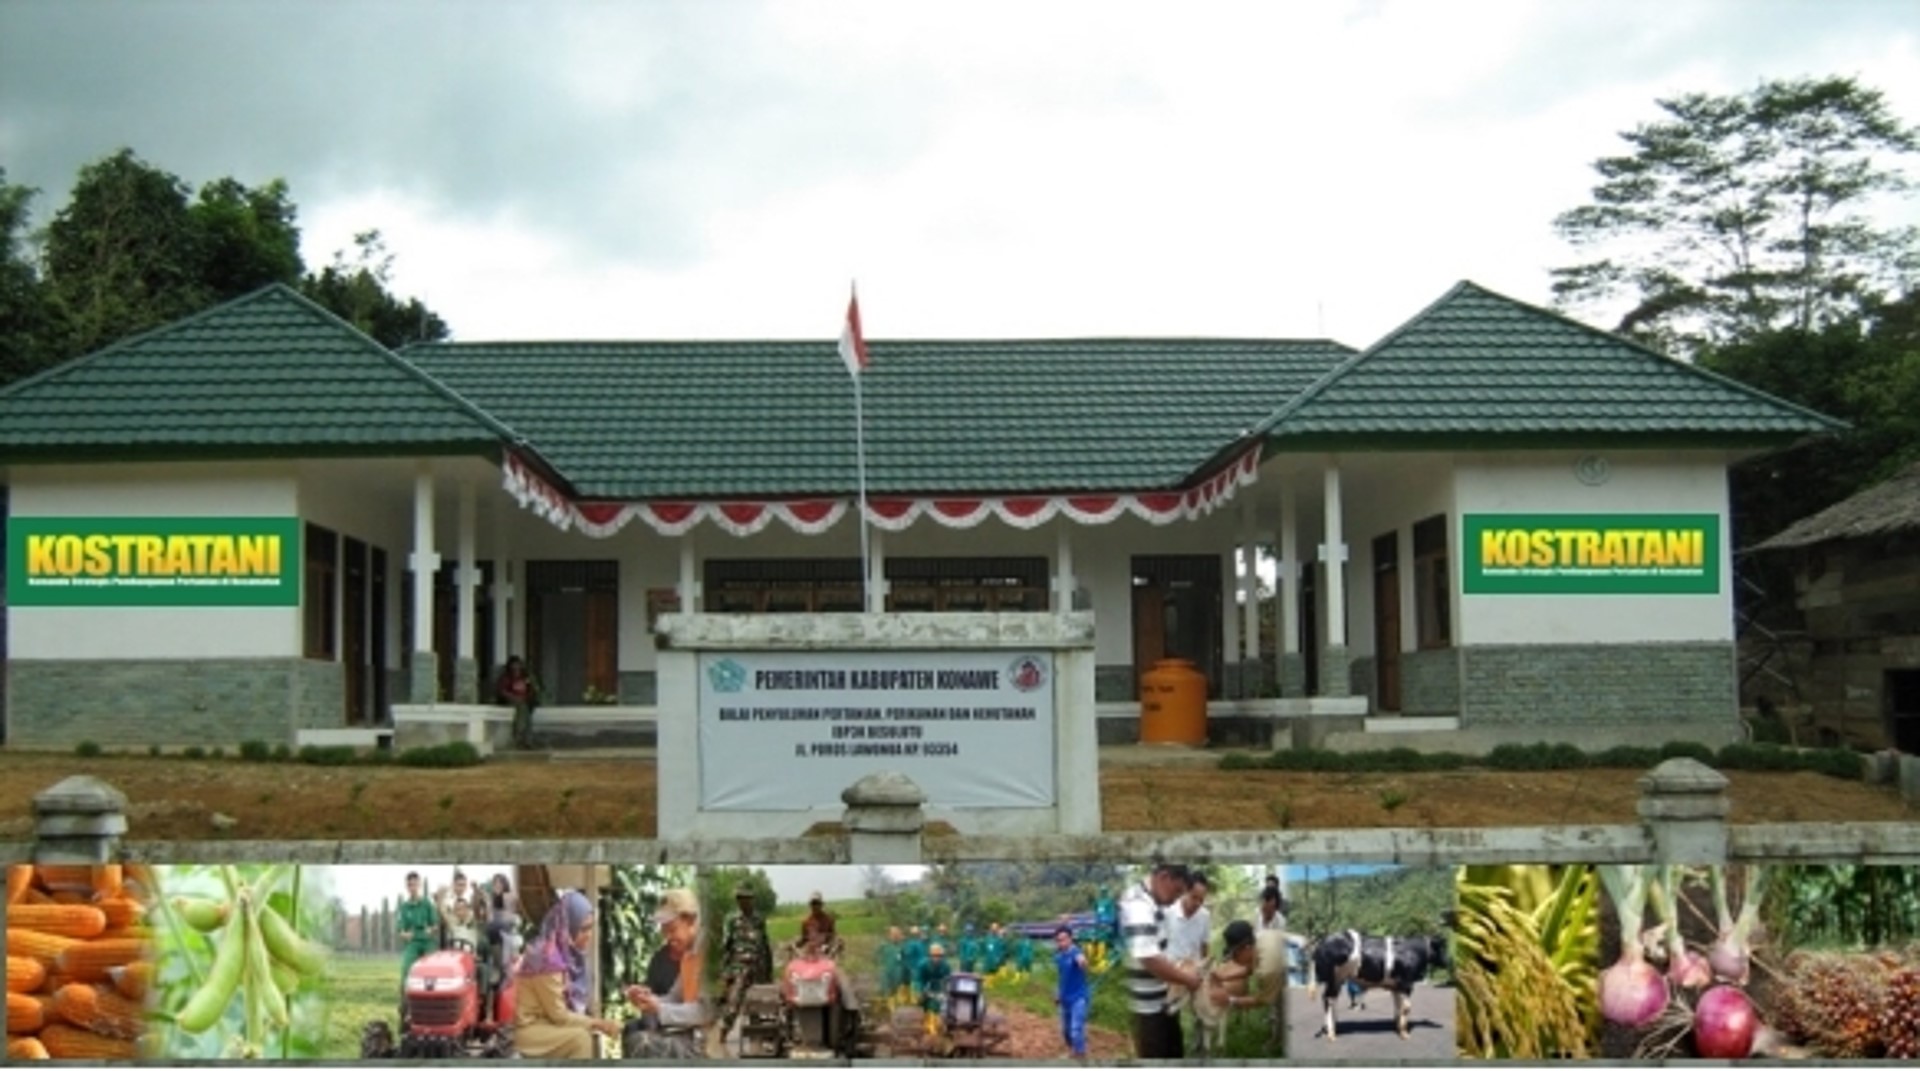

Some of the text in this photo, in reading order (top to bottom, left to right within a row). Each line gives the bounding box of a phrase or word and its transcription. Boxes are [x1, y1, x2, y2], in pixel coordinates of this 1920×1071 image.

[27, 534, 281, 576] KOSTRATANI
[1481, 529, 1704, 567] KOSTRATANI
[755, 669, 846, 690] PEMERINTAH
[850, 669, 934, 690] KABUPATEN
[937, 669, 1000, 690] KONAWE
[949, 707, 970, 721] DAN
